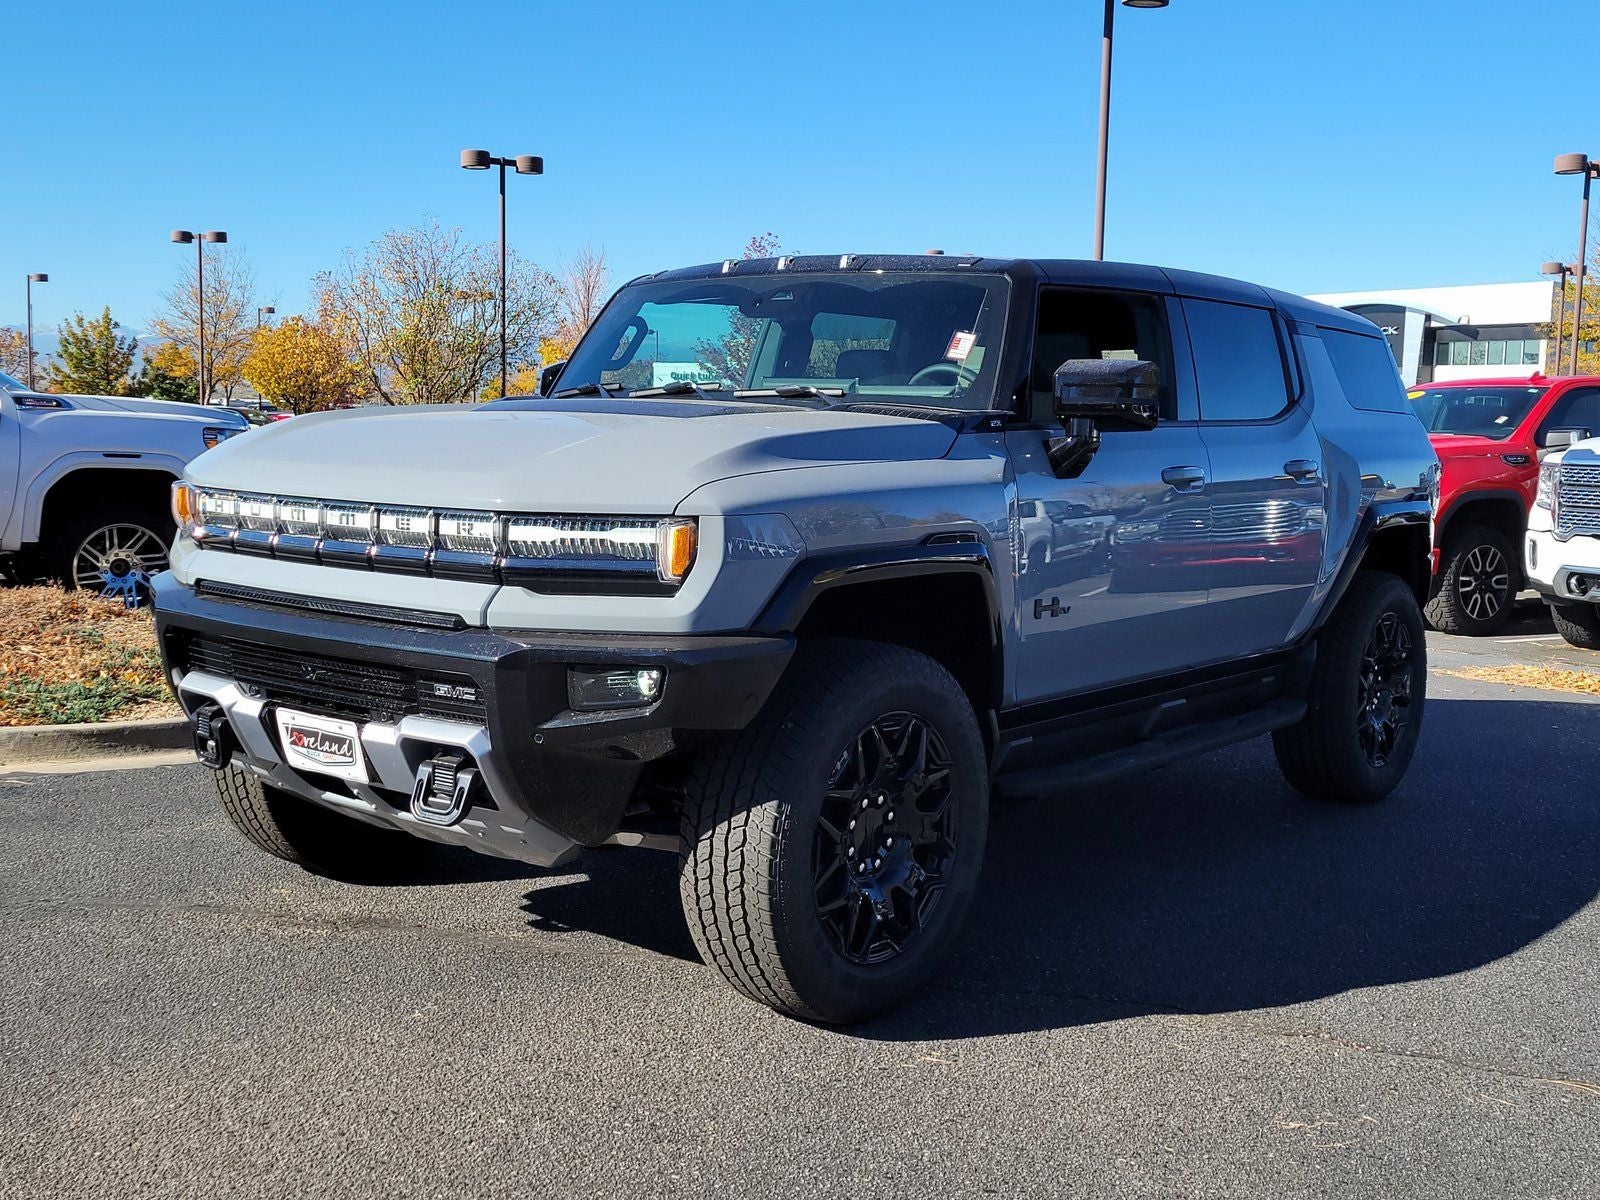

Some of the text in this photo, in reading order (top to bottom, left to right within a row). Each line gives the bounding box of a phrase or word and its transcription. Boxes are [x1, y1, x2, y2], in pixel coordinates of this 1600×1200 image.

[670, 371, 697, 382] Quick
[214, 499, 474, 536] HUMMER
[434, 683, 477, 701] GMC
